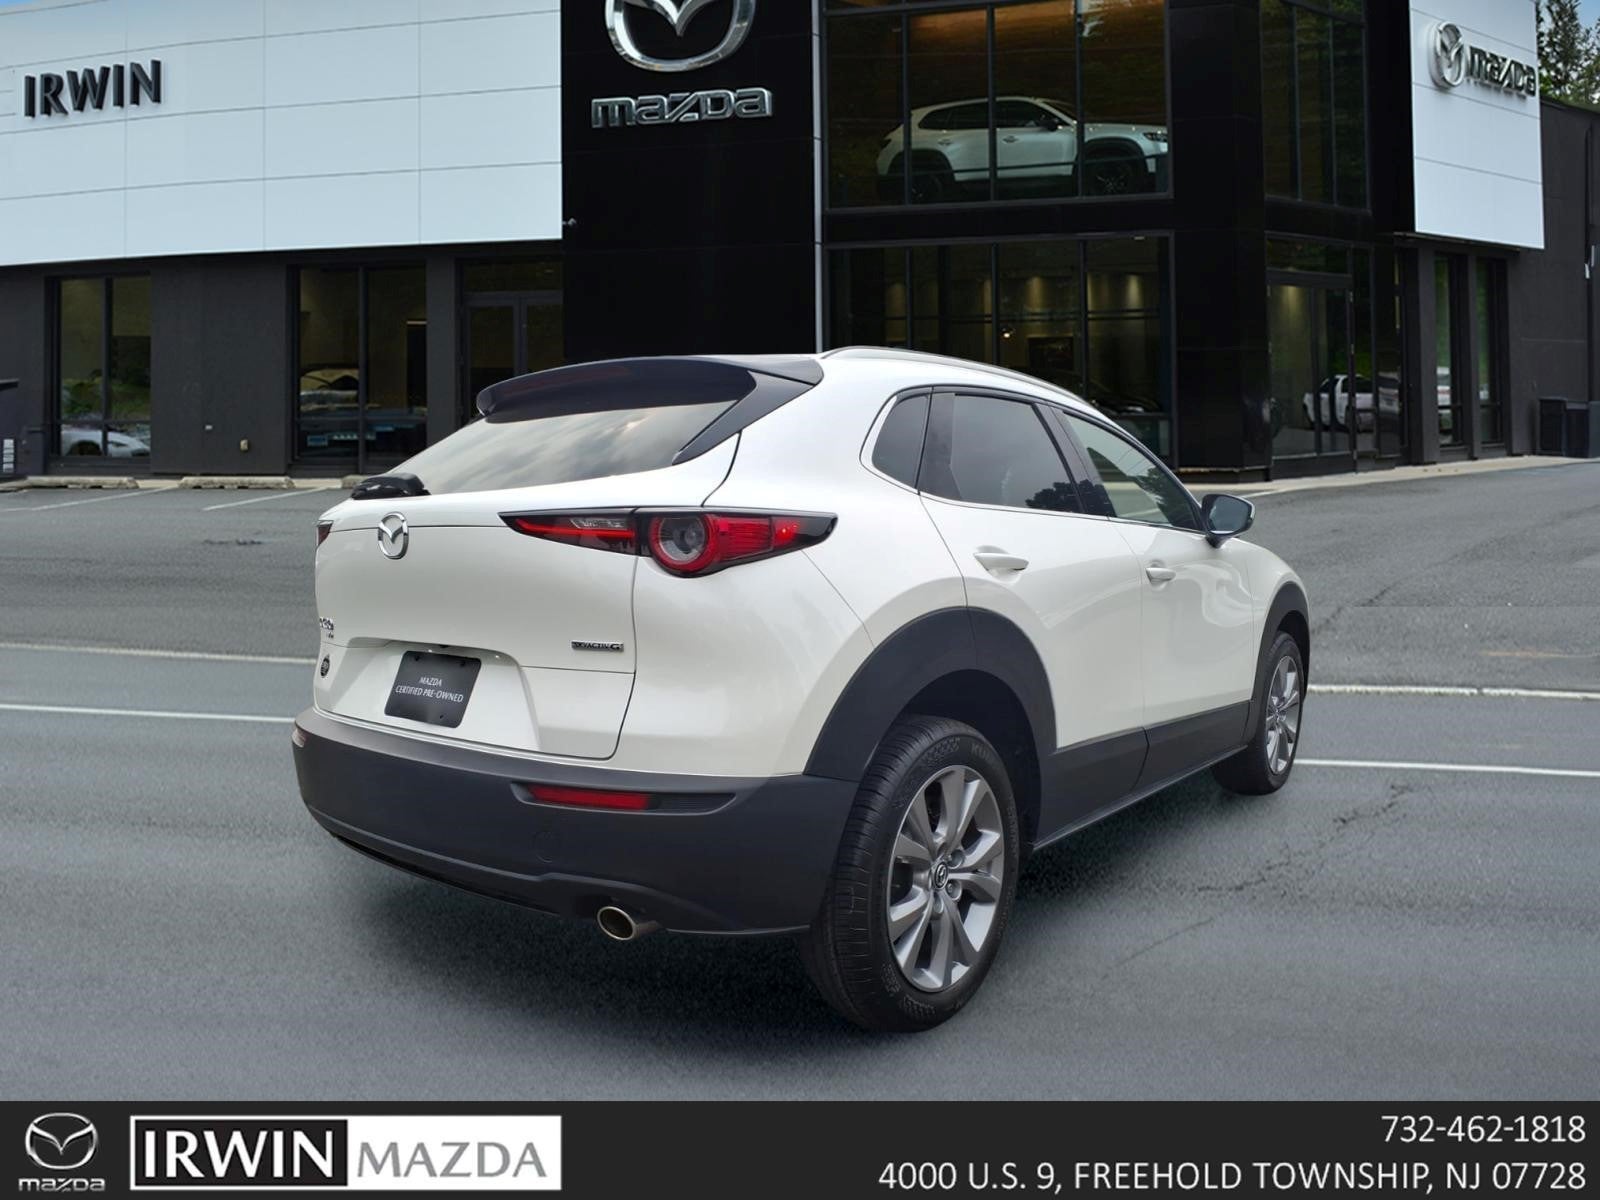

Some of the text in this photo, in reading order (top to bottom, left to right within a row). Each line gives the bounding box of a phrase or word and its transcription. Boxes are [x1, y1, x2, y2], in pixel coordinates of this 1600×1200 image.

[24, 59, 162, 118] IRWIN
[419, 676, 443, 687] MAZDA
[395, 685, 464, 702] CERTIFIED PRE-OWNED
